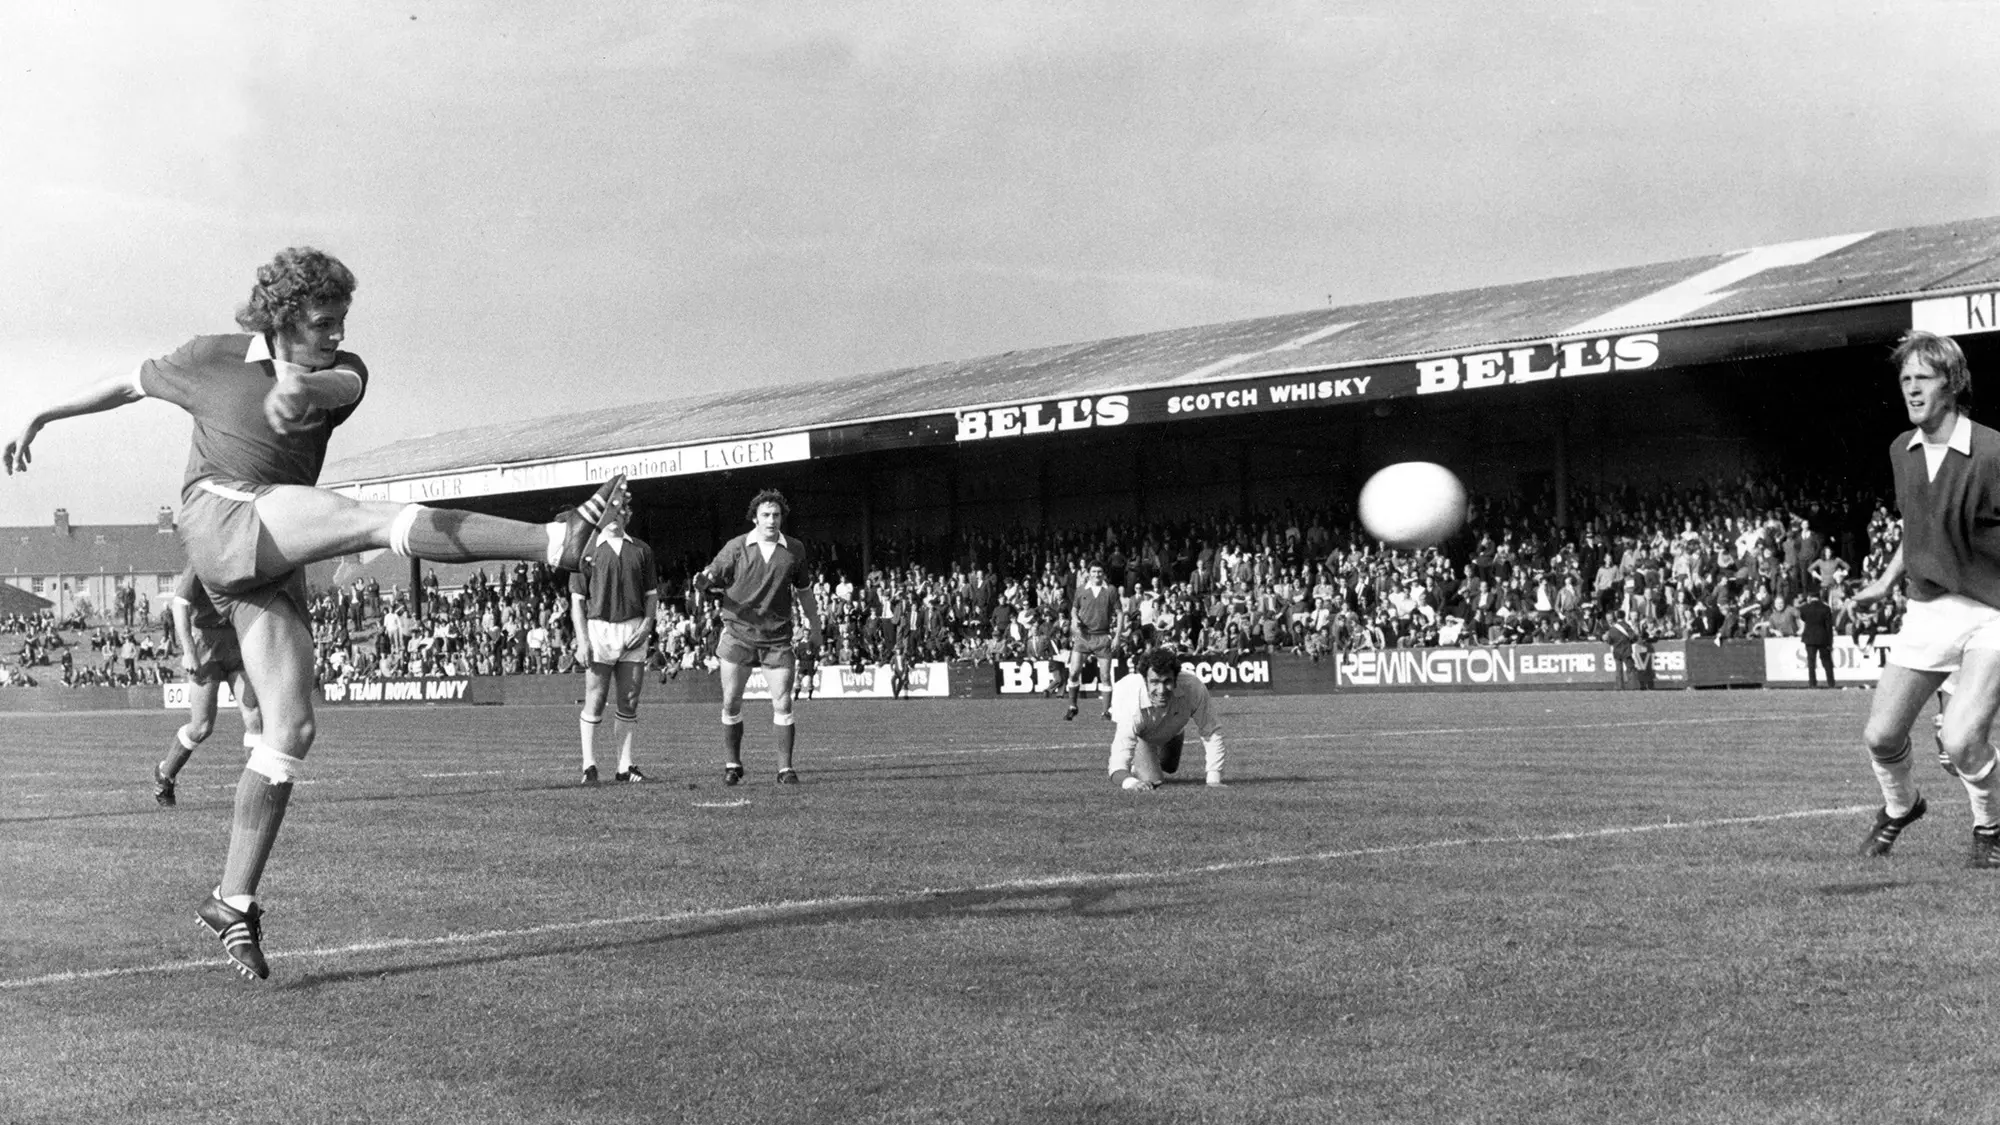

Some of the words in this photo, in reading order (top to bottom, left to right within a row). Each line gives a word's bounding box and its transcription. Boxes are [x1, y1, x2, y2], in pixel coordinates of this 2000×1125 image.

[1415, 332, 1660, 395] BELL'S
[1167, 389, 1258, 414] SCOTCH
[1269, 376, 1371, 402] WHISKY
[955, 395, 1130, 441] BELL'S
[585, 451, 683, 482] International
[704, 440, 775, 469] LAGER
[1335, 649, 1516, 685] REMINGTON
[1520, 653, 1596, 673] ELECTRIC
[324, 683, 346, 701] TOP
[349, 682, 383, 700] TEAM
[384, 681, 423, 700] ROYAL
[426, 680, 468, 700] NAVY
